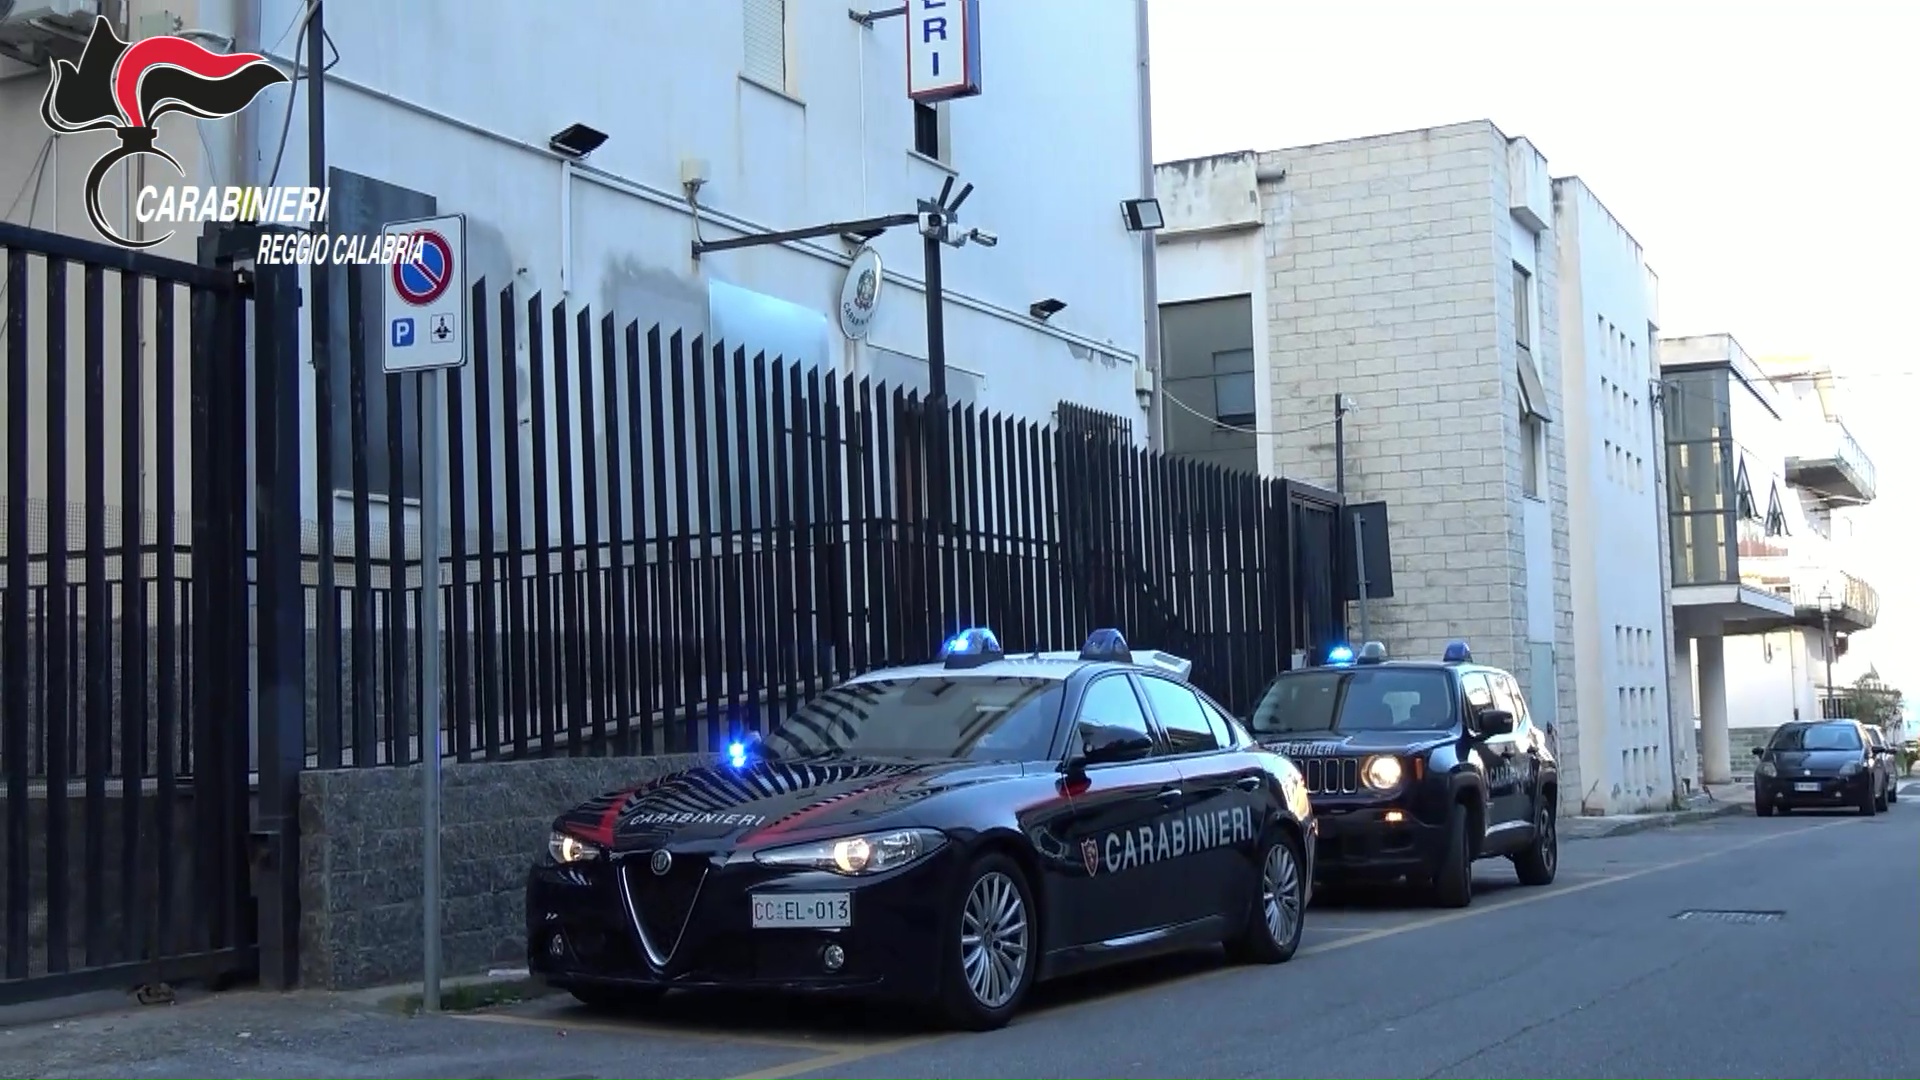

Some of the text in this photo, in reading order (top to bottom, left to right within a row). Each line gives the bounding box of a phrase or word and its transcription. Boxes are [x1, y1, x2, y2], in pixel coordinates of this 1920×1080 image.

[396, 321, 410, 344] P
[1264, 742, 1337, 756] RABINIERI
[630, 812, 765, 826] CARABINIERI
[1105, 805, 1252, 873] CARABINIERI
